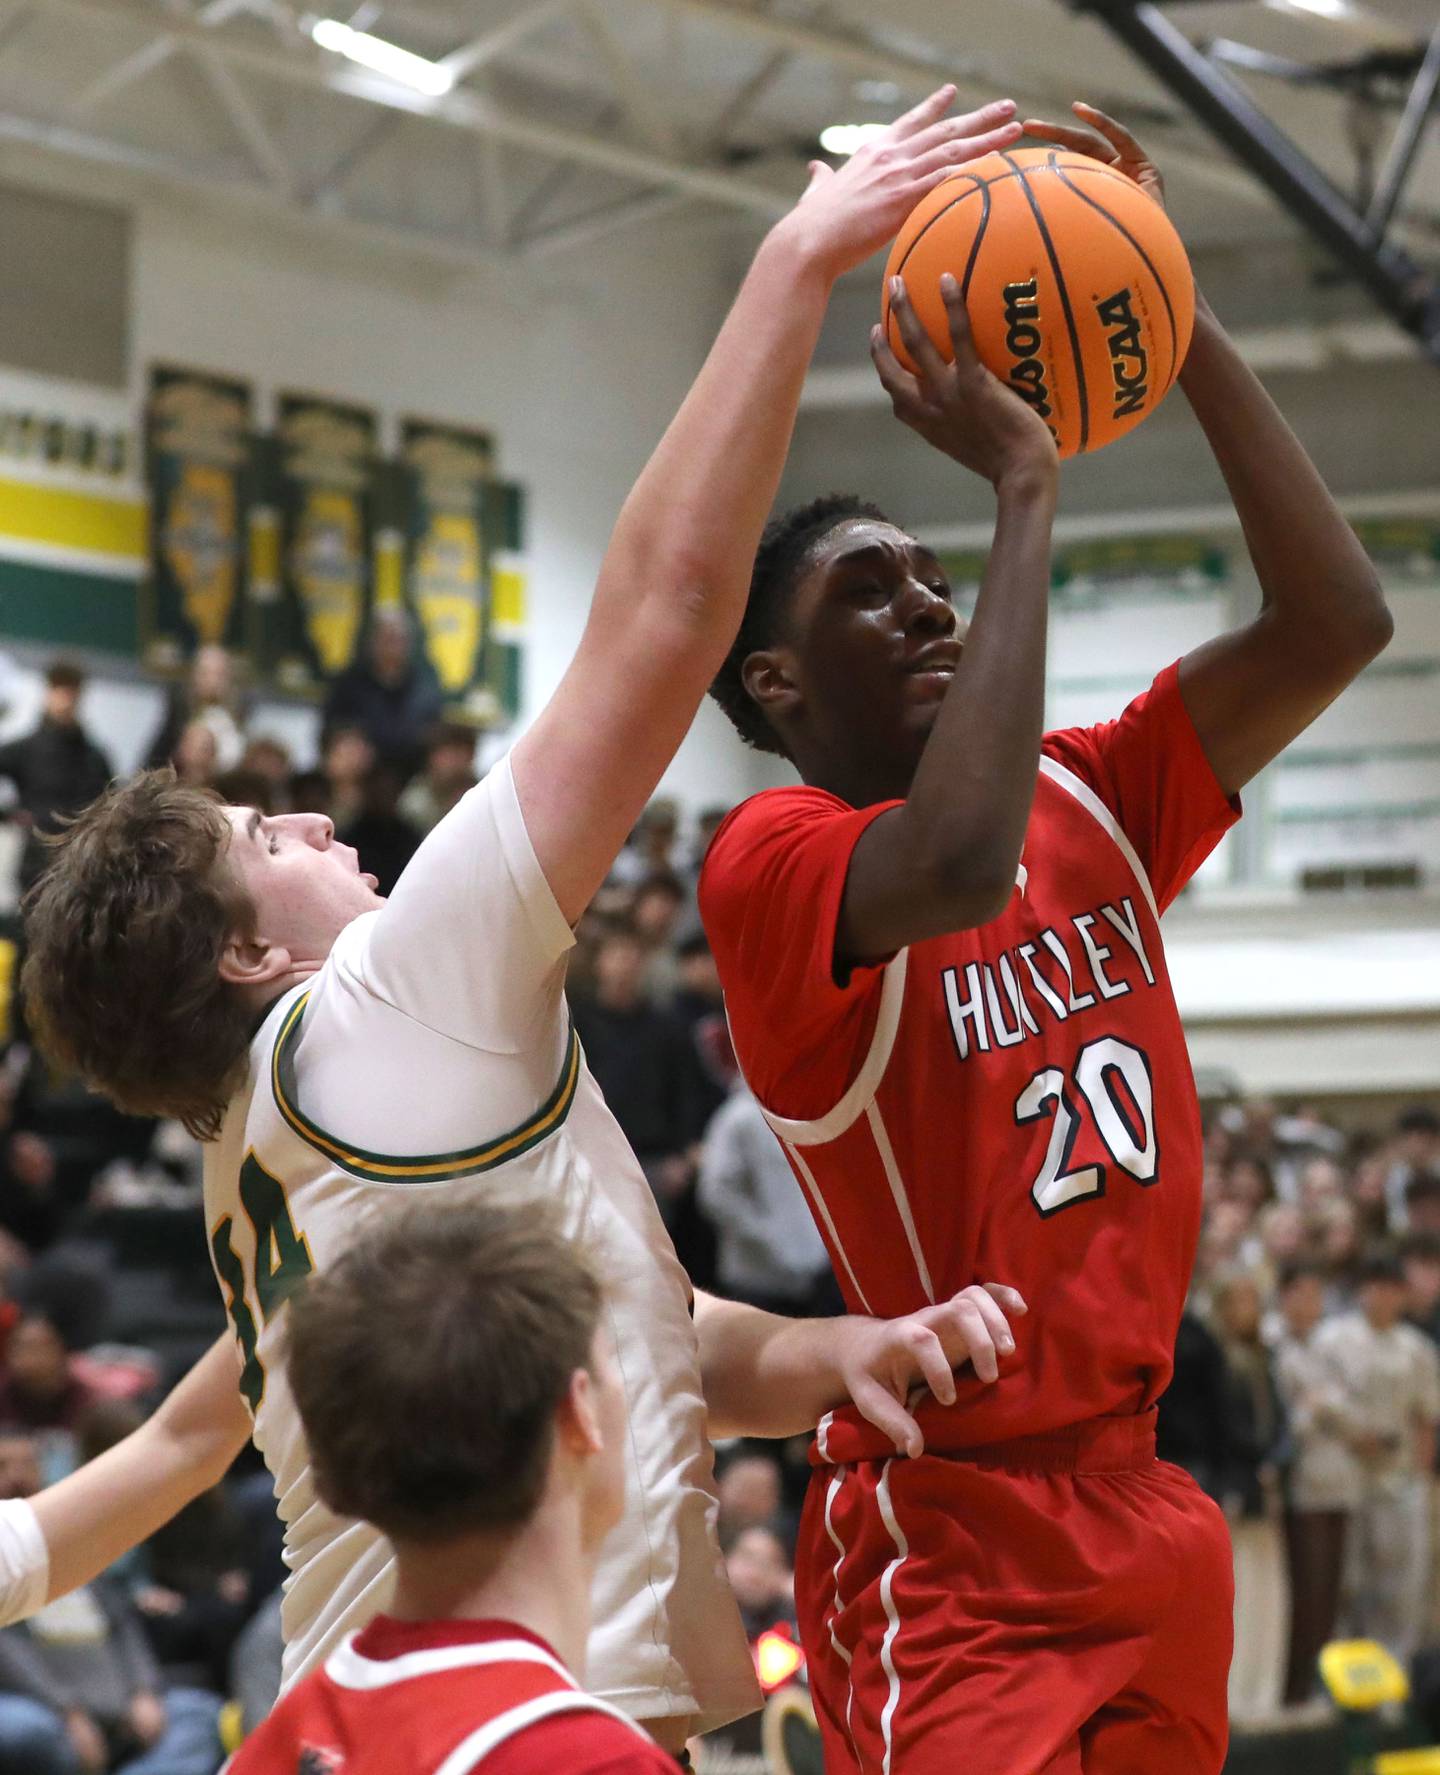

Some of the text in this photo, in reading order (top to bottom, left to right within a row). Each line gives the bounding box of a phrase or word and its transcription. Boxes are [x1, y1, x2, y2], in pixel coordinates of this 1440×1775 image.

[1003, 277, 1062, 448] lson
[1096, 288, 1148, 420] NCAA
[1015, 1034, 1160, 1219] 20
